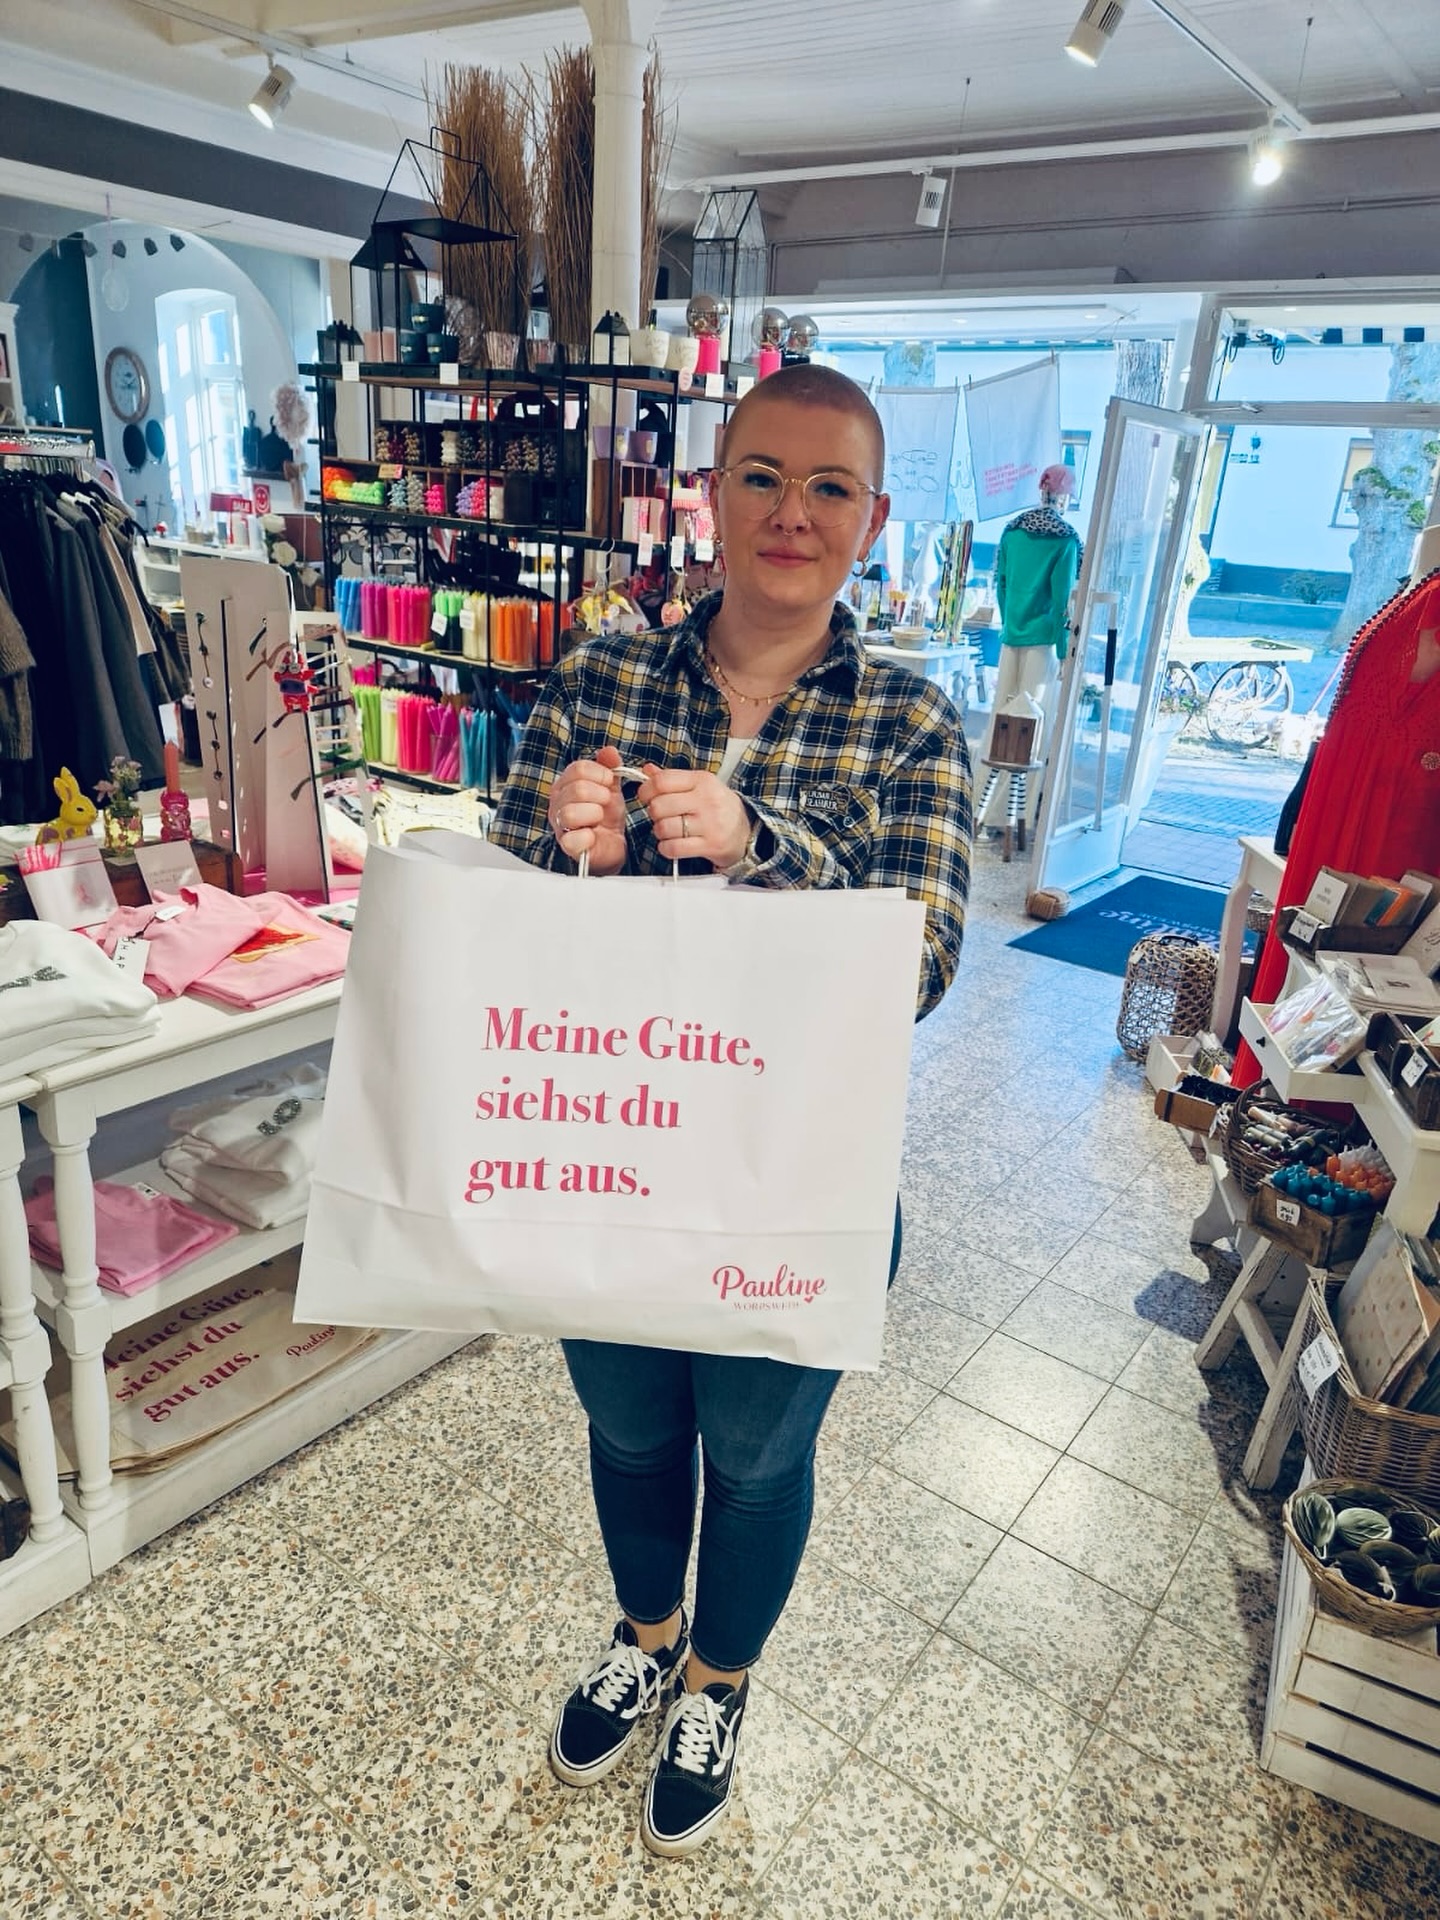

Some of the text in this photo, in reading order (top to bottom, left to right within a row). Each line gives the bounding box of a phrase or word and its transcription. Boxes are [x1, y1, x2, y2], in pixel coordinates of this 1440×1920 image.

[480, 1006, 765, 1076] Meine Güte,
[475, 1076, 682, 1129] siehst du
[463, 1156, 651, 1204] gut aus.
[179, 1287, 264, 1322] Güte,
[712, 1263, 826, 1301] Pauline
[115, 1319, 244, 1402] siehst du
[143, 1350, 261, 1423] gut aus.
